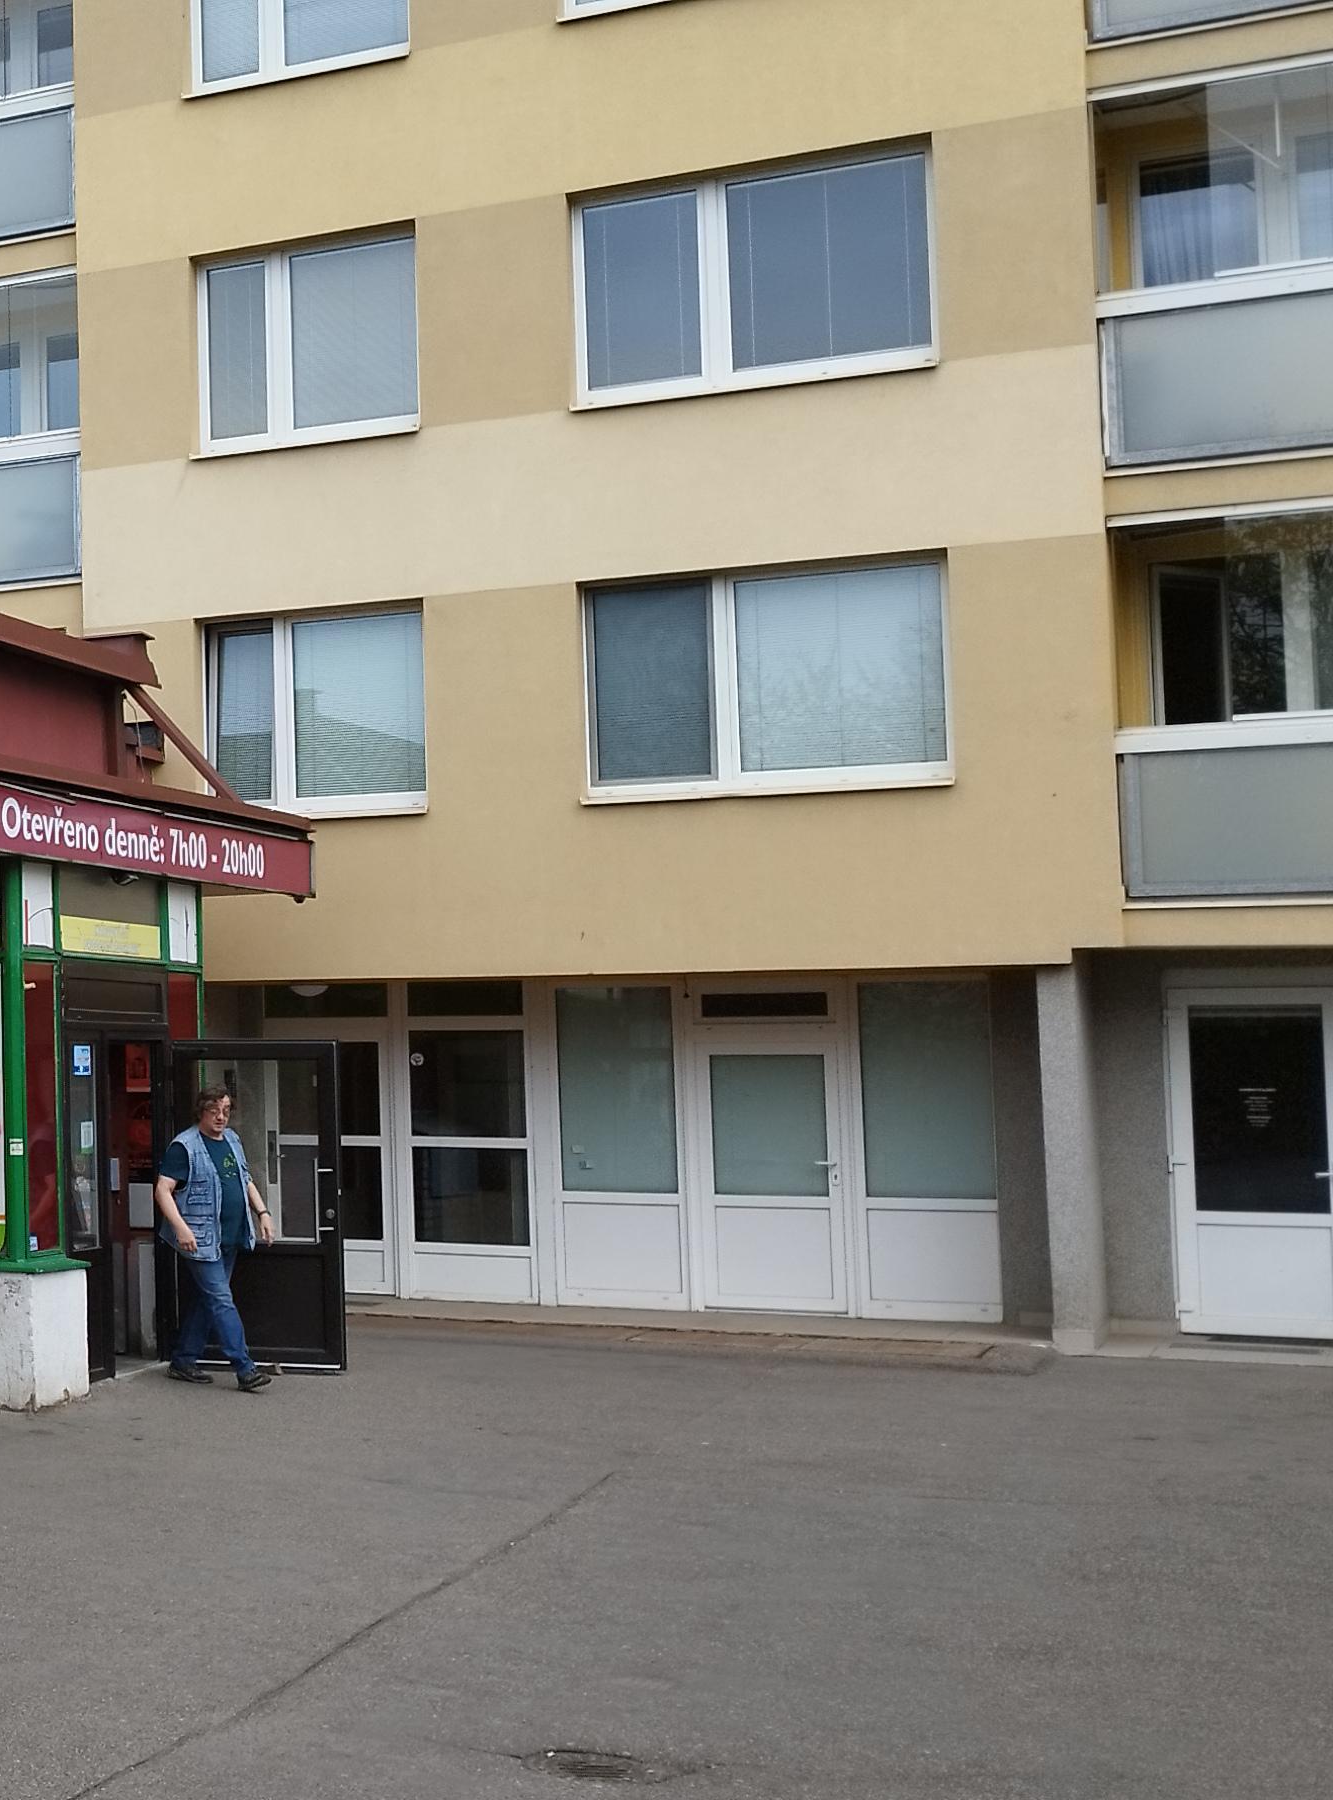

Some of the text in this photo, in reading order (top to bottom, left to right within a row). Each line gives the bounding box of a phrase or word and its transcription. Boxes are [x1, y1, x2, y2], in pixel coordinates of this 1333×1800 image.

[1, 796, 100, 852] Otevřeno
[104, 818, 166, 865] denně:
[169, 827, 208, 870] 7h00
[221, 838, 265, 879] 20h00
